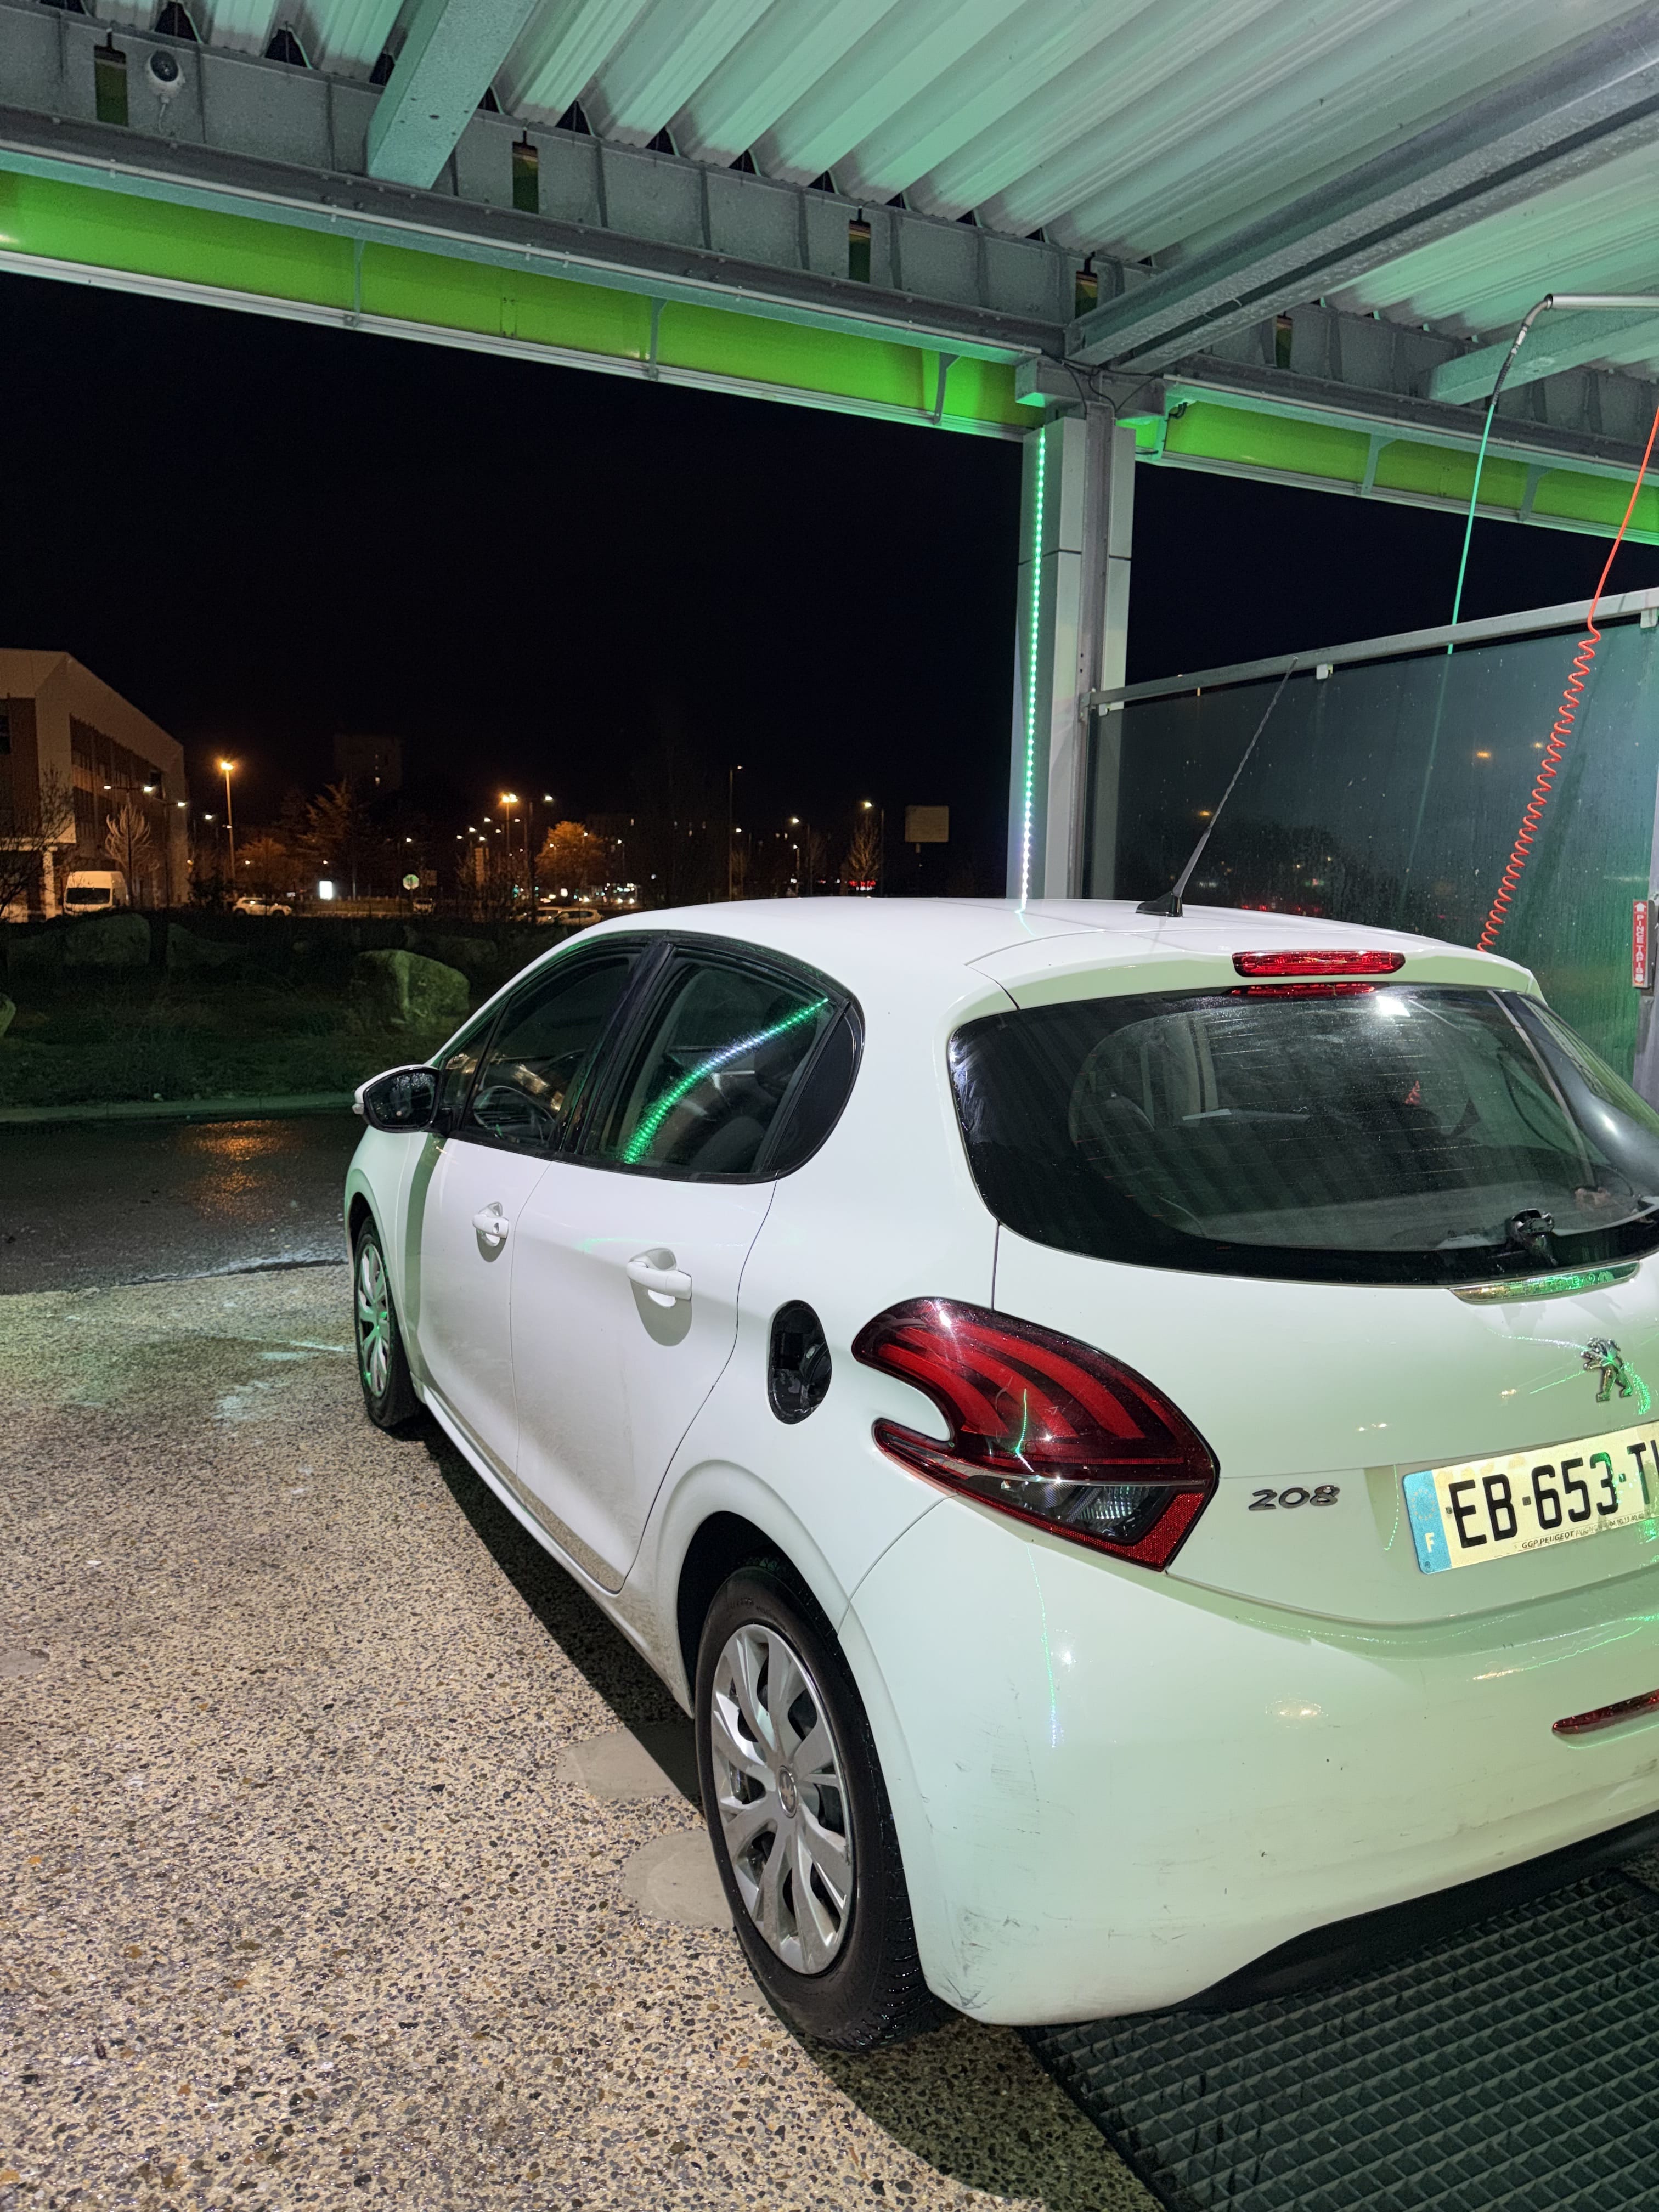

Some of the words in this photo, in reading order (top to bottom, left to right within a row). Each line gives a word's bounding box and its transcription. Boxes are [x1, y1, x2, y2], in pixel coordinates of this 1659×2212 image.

[1635, 915, 1645, 944] PINCE
[1635, 945, 1644, 973] TAPIS
[1248, 1485, 1340, 1510] 208
[1425, 1532, 1435, 1553] F
[1522, 1539, 1538, 1549] GGP
[1539, 1530, 1575, 1544] PEUGEOT
